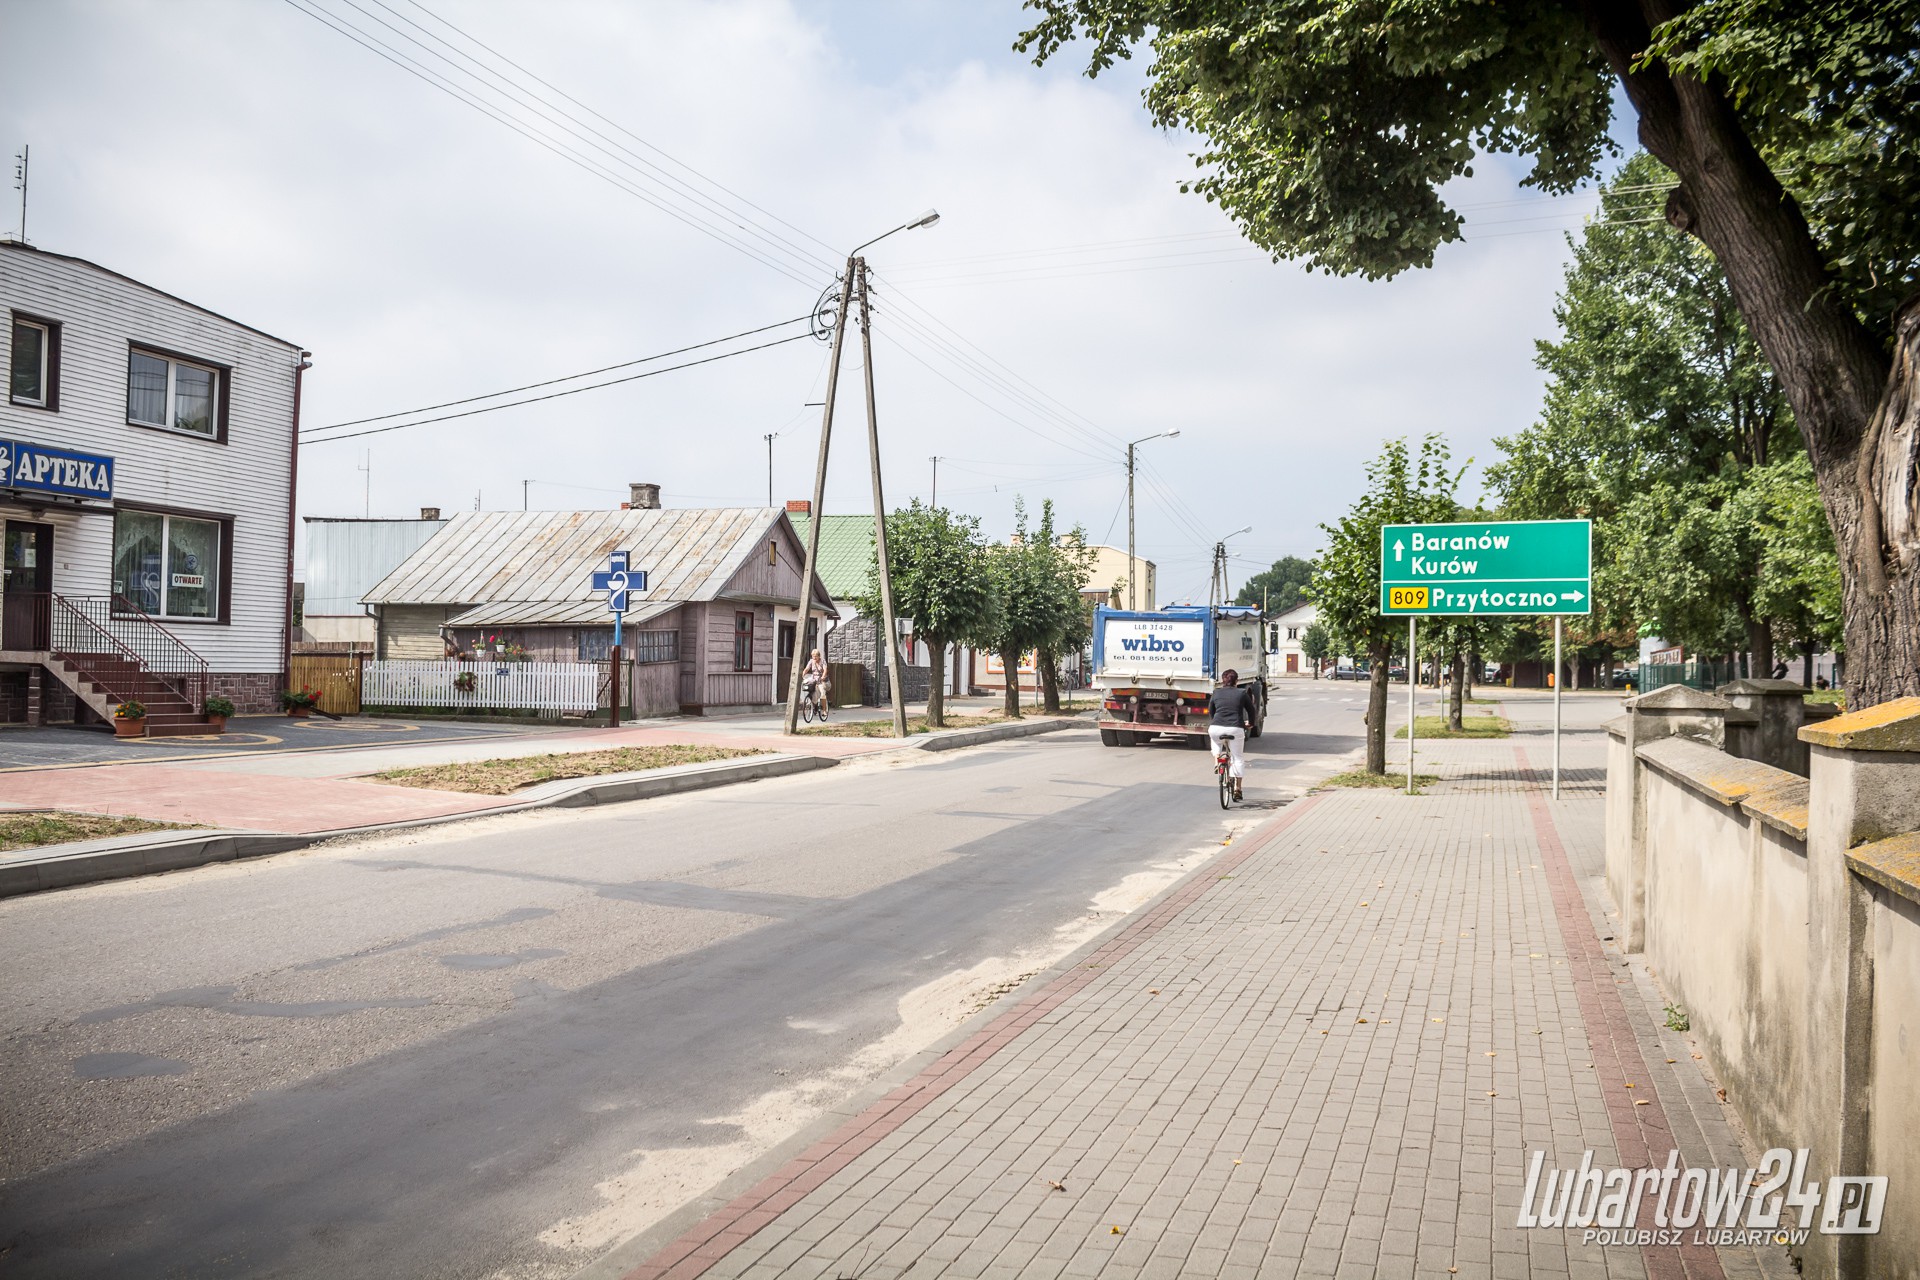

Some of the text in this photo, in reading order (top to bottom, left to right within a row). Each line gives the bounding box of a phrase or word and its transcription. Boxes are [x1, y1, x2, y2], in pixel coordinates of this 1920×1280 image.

[15, 452, 110, 492] APTEKA
[1411, 530, 1510, 552] Baranów
[1411, 556, 1478, 575] Kurów
[174, 575, 203, 585] OTWARTE
[1394, 588, 1557, 612] 809 Przytoczno
[1121, 634, 1185, 652] wibro
